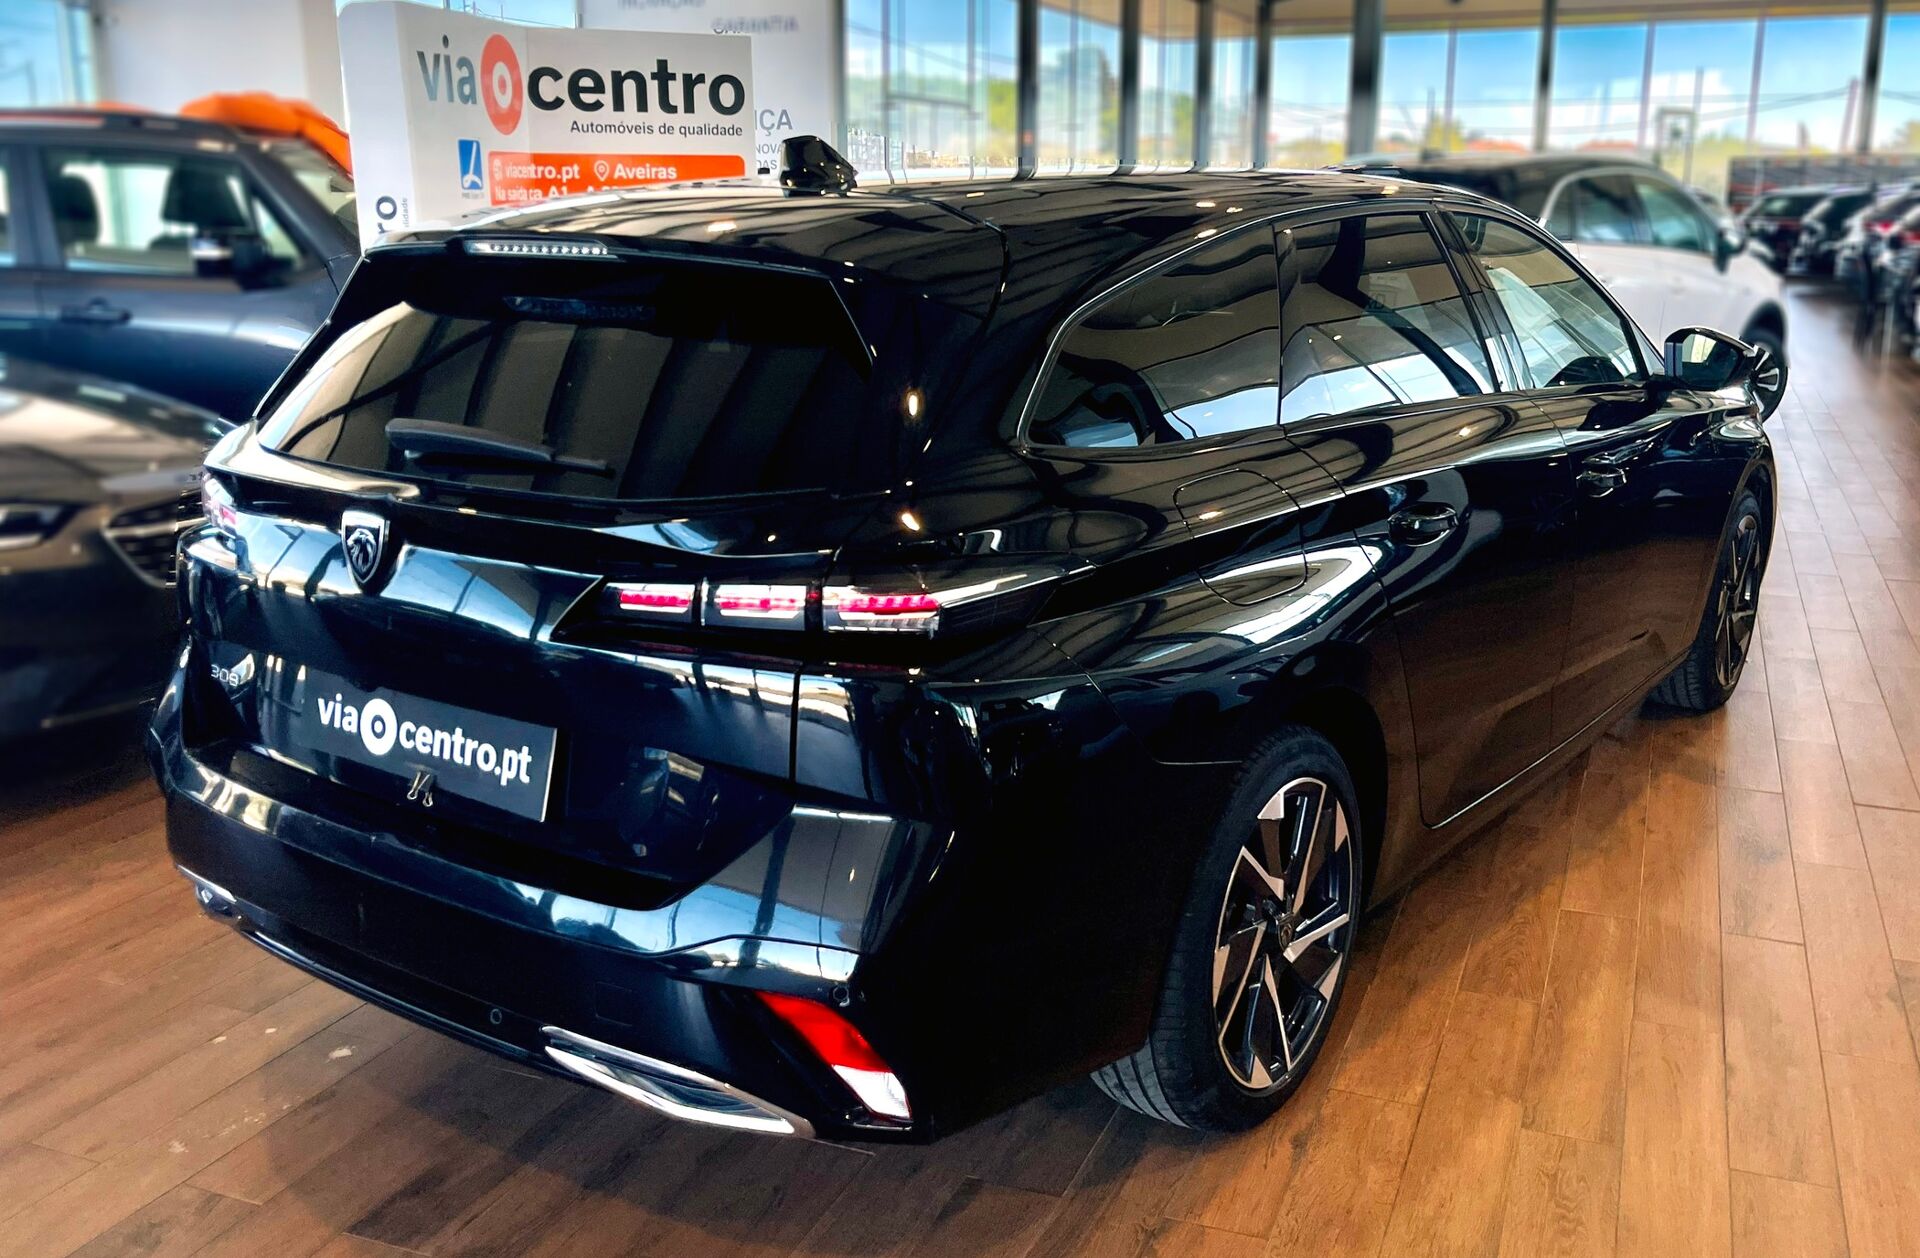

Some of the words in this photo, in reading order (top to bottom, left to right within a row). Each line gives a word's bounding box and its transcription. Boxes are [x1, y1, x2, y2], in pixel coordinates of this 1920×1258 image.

[570, 120, 654, 135] Automóveis
[658, 122, 675, 136] de
[679, 123, 743, 138] qualidade
[613, 162, 677, 180] Aveiras
[211, 664, 239, 687] 308
